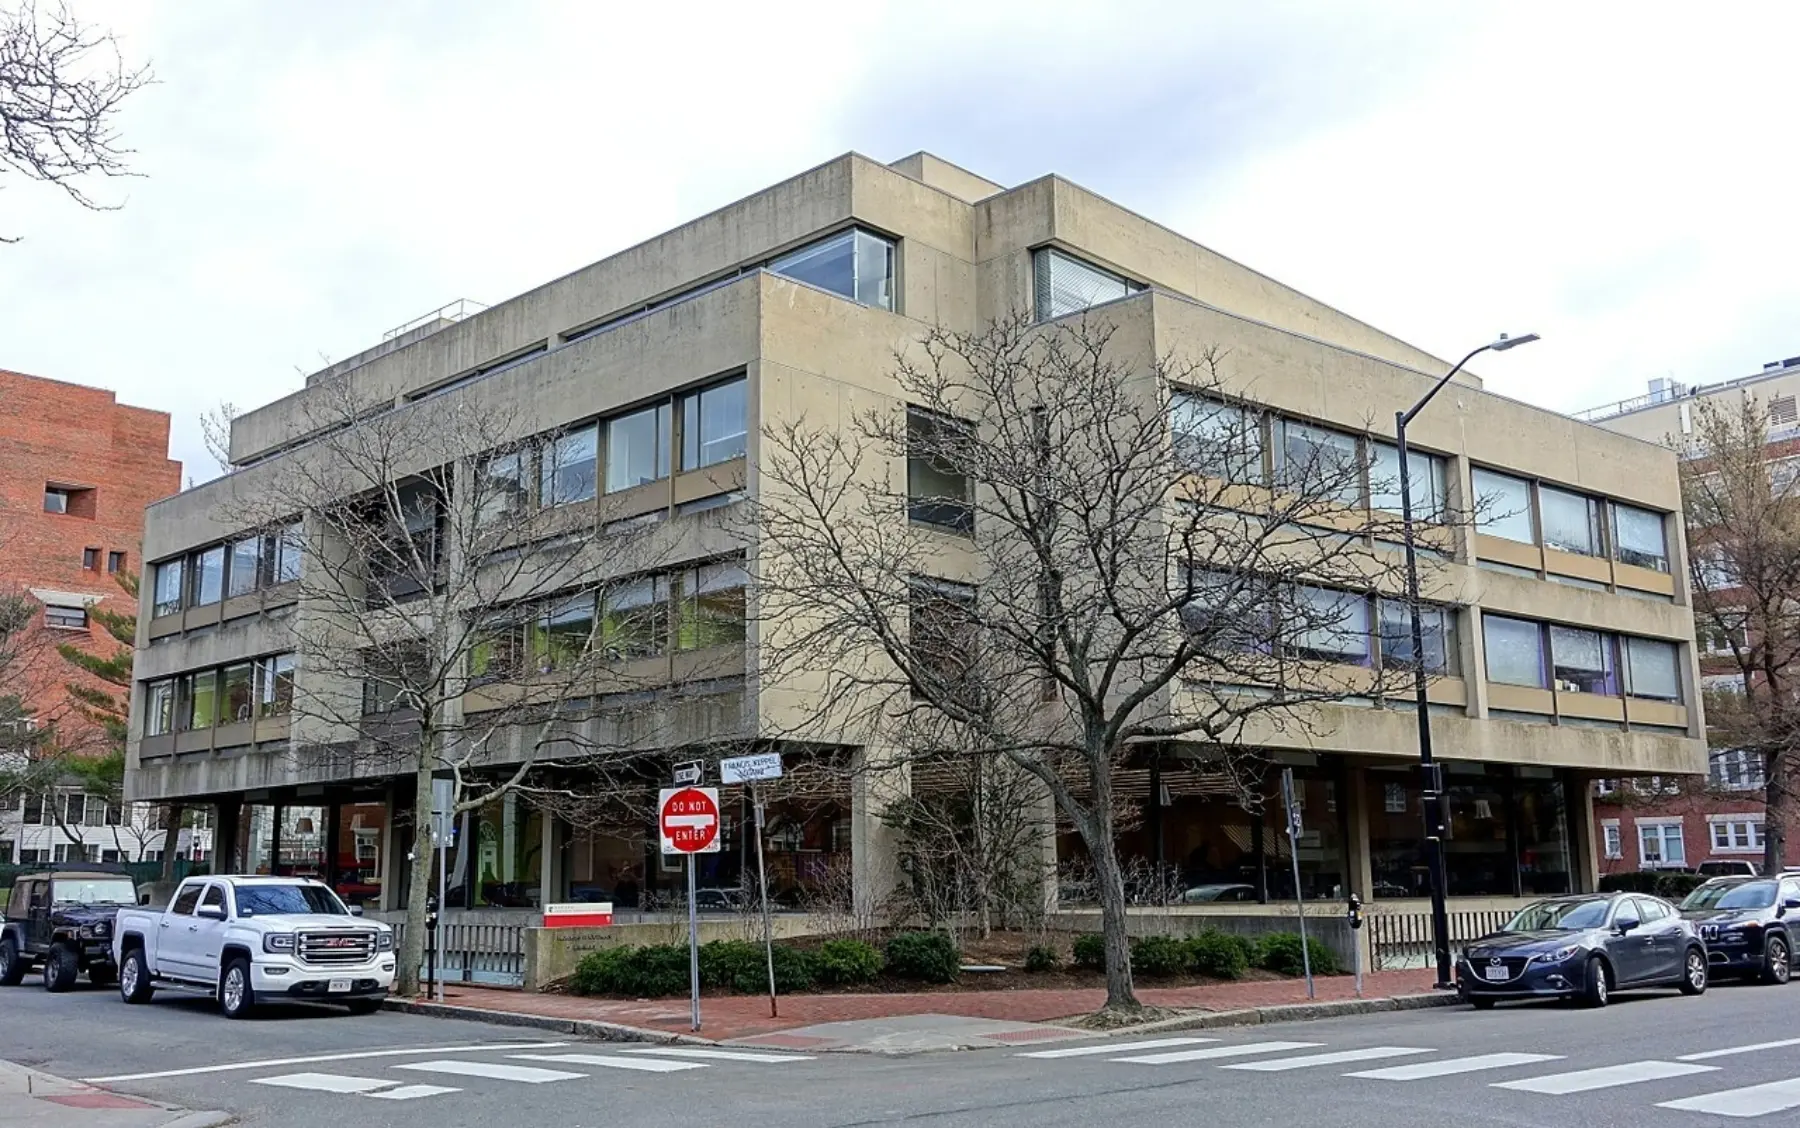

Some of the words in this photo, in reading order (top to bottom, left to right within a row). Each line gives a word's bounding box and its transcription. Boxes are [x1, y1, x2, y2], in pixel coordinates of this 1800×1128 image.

[672, 801, 685, 812] DO
[689, 801, 707, 811] NOT
[676, 830, 706, 841] ENTER
